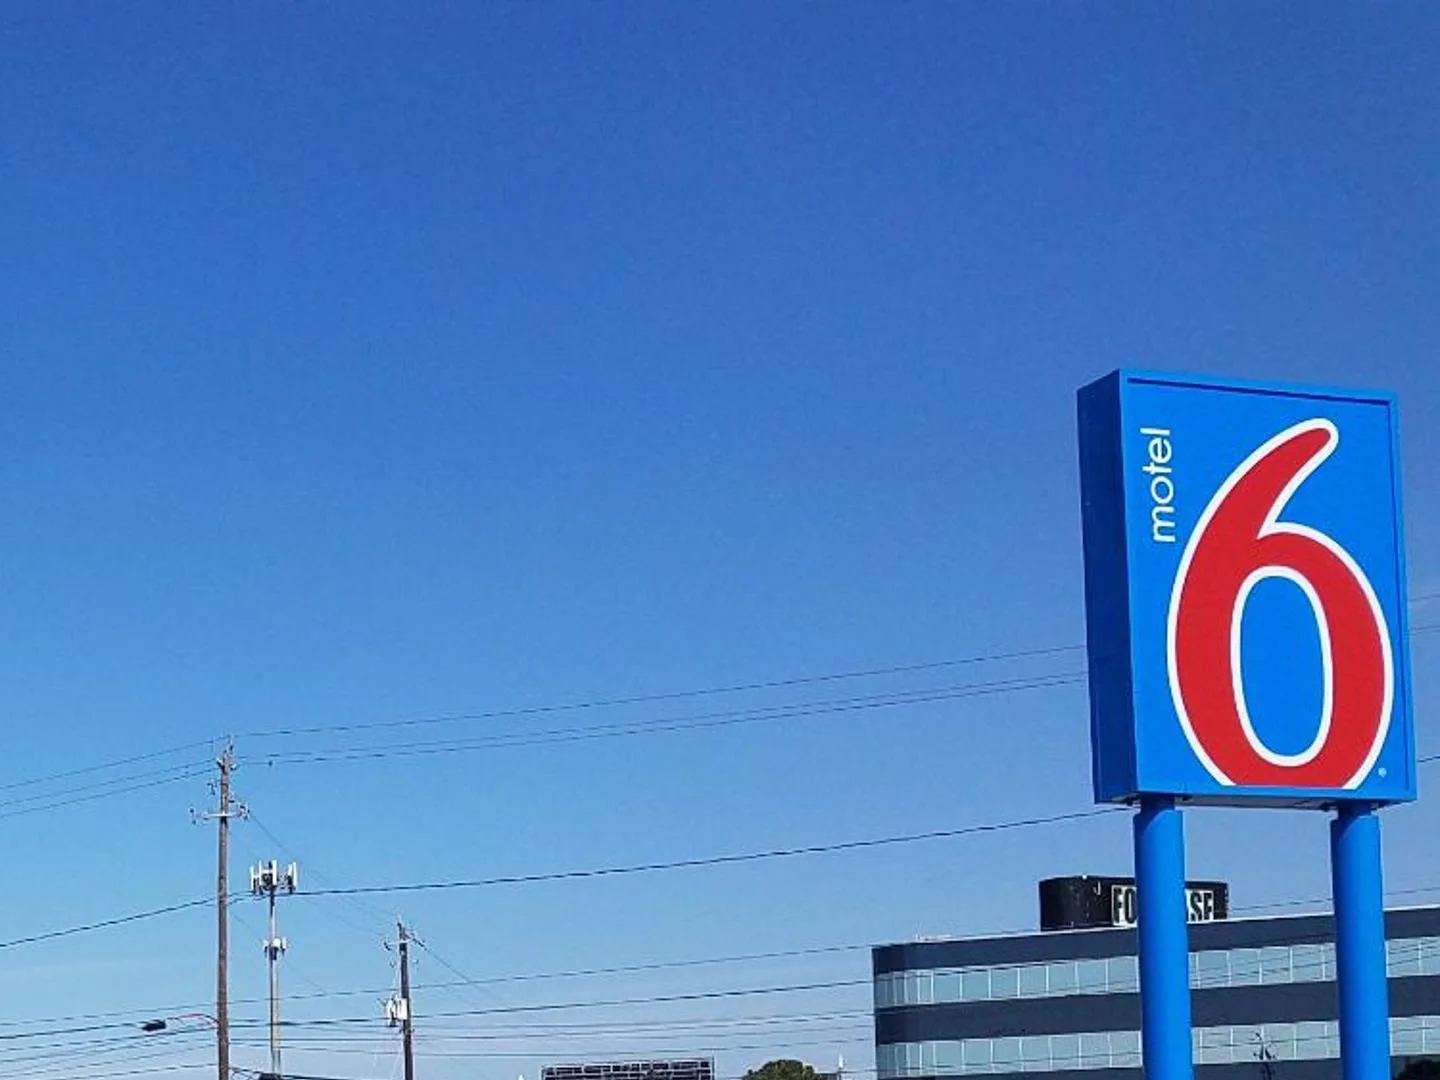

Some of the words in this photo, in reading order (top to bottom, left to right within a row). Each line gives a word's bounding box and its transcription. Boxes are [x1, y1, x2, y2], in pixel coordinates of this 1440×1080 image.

[1140, 427, 1176, 543] motel
[1166, 417, 1394, 790] 6
[1113, 887, 1137, 924] FO
